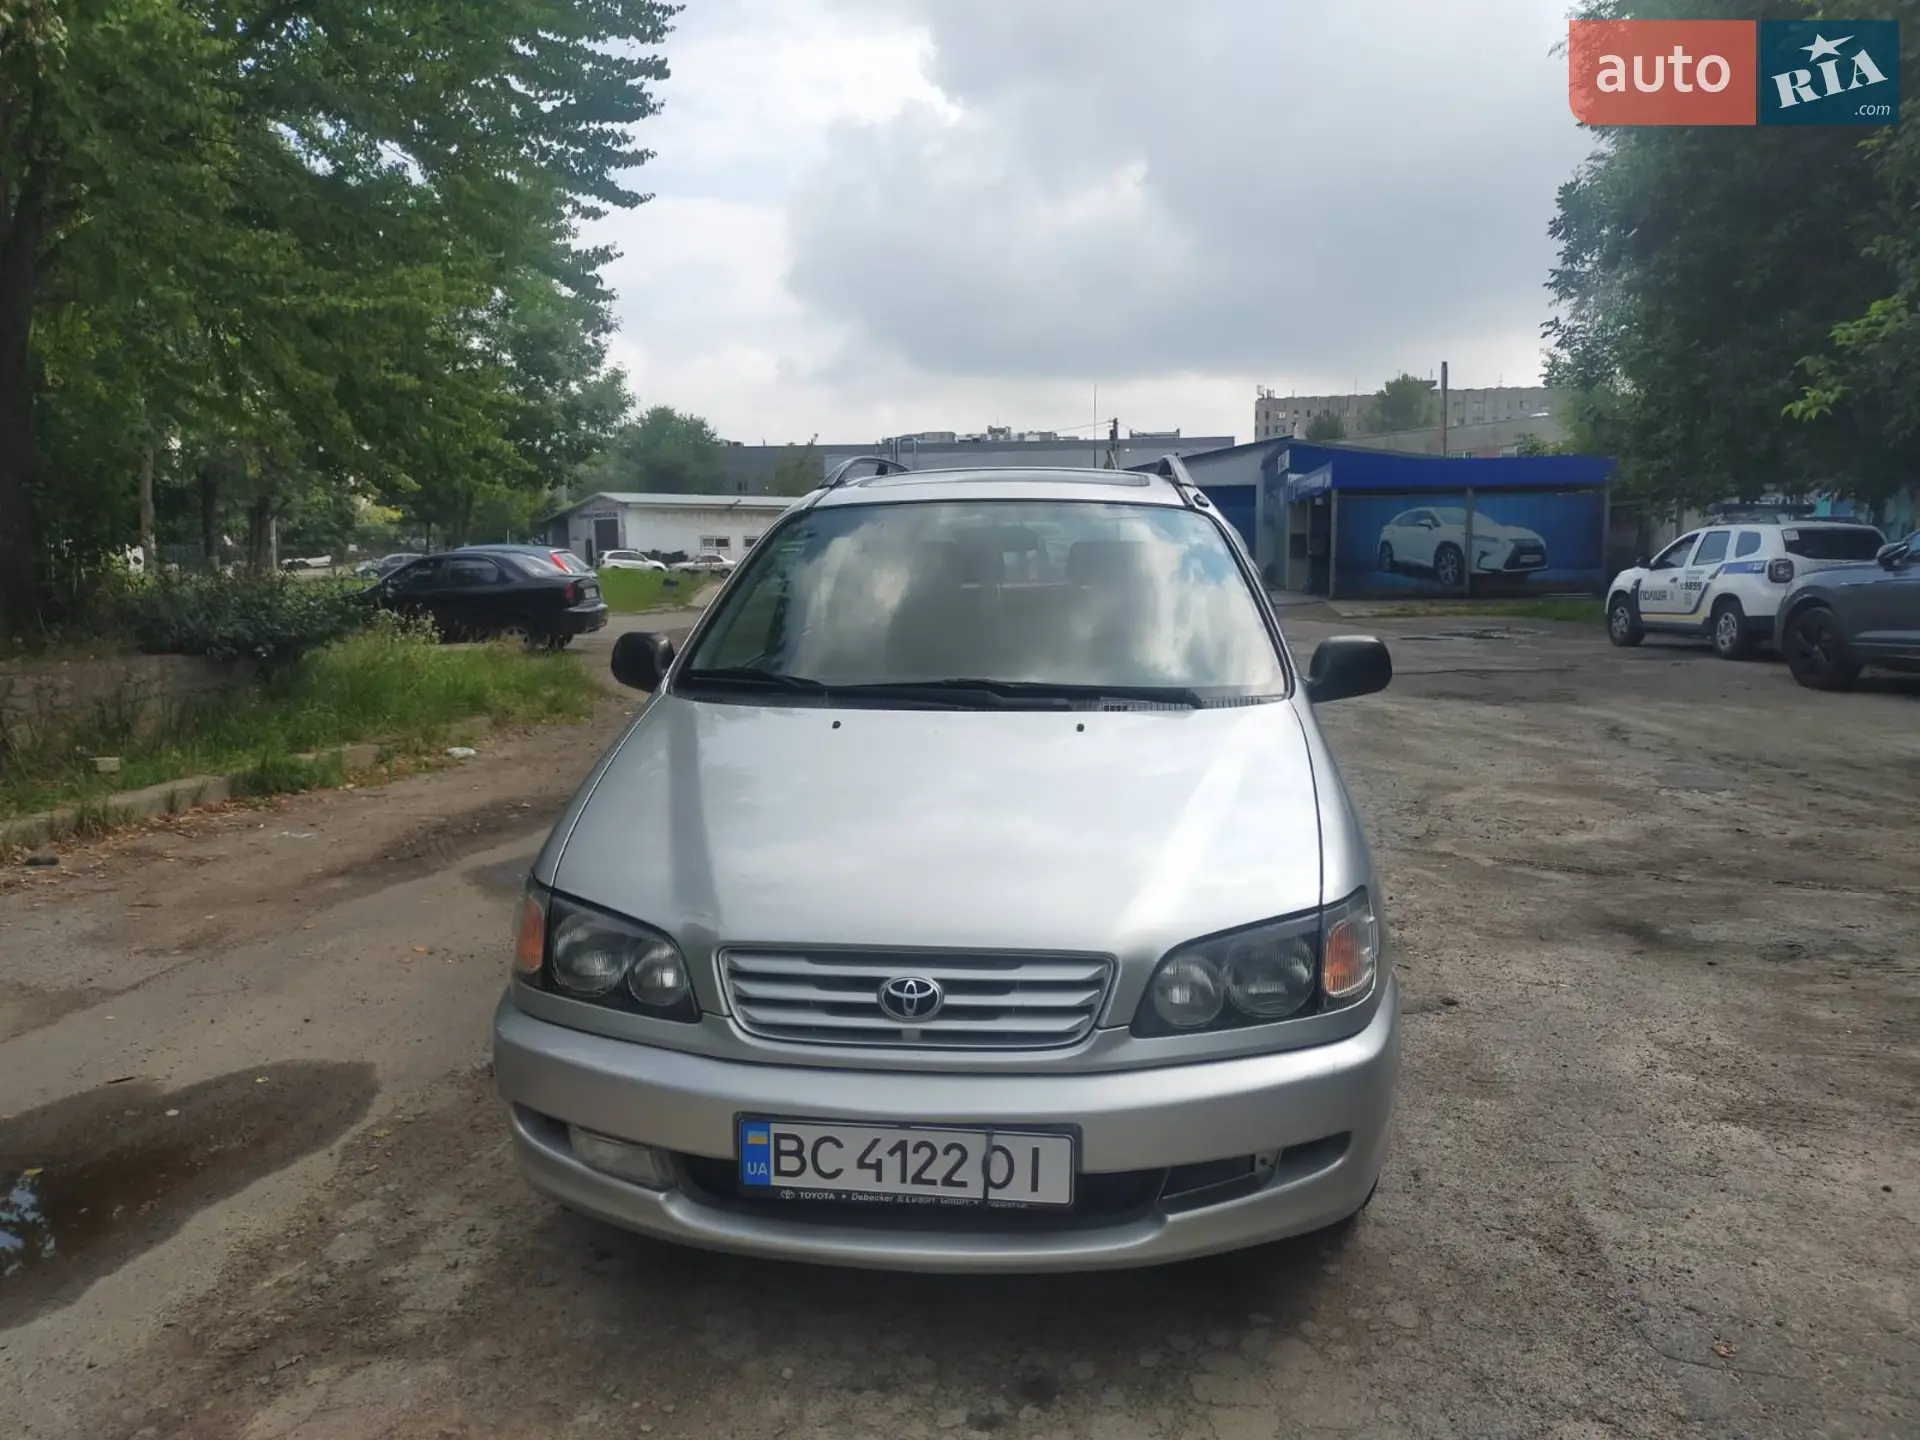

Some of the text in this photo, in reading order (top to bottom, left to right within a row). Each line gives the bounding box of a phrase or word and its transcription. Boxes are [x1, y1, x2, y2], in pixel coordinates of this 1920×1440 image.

[773, 1132, 844, 1180] BC
[856, 1137, 969, 1188] 4122
[747, 1161, 768, 1176] UA
[799, 1191, 836, 1201] TOYOTA
